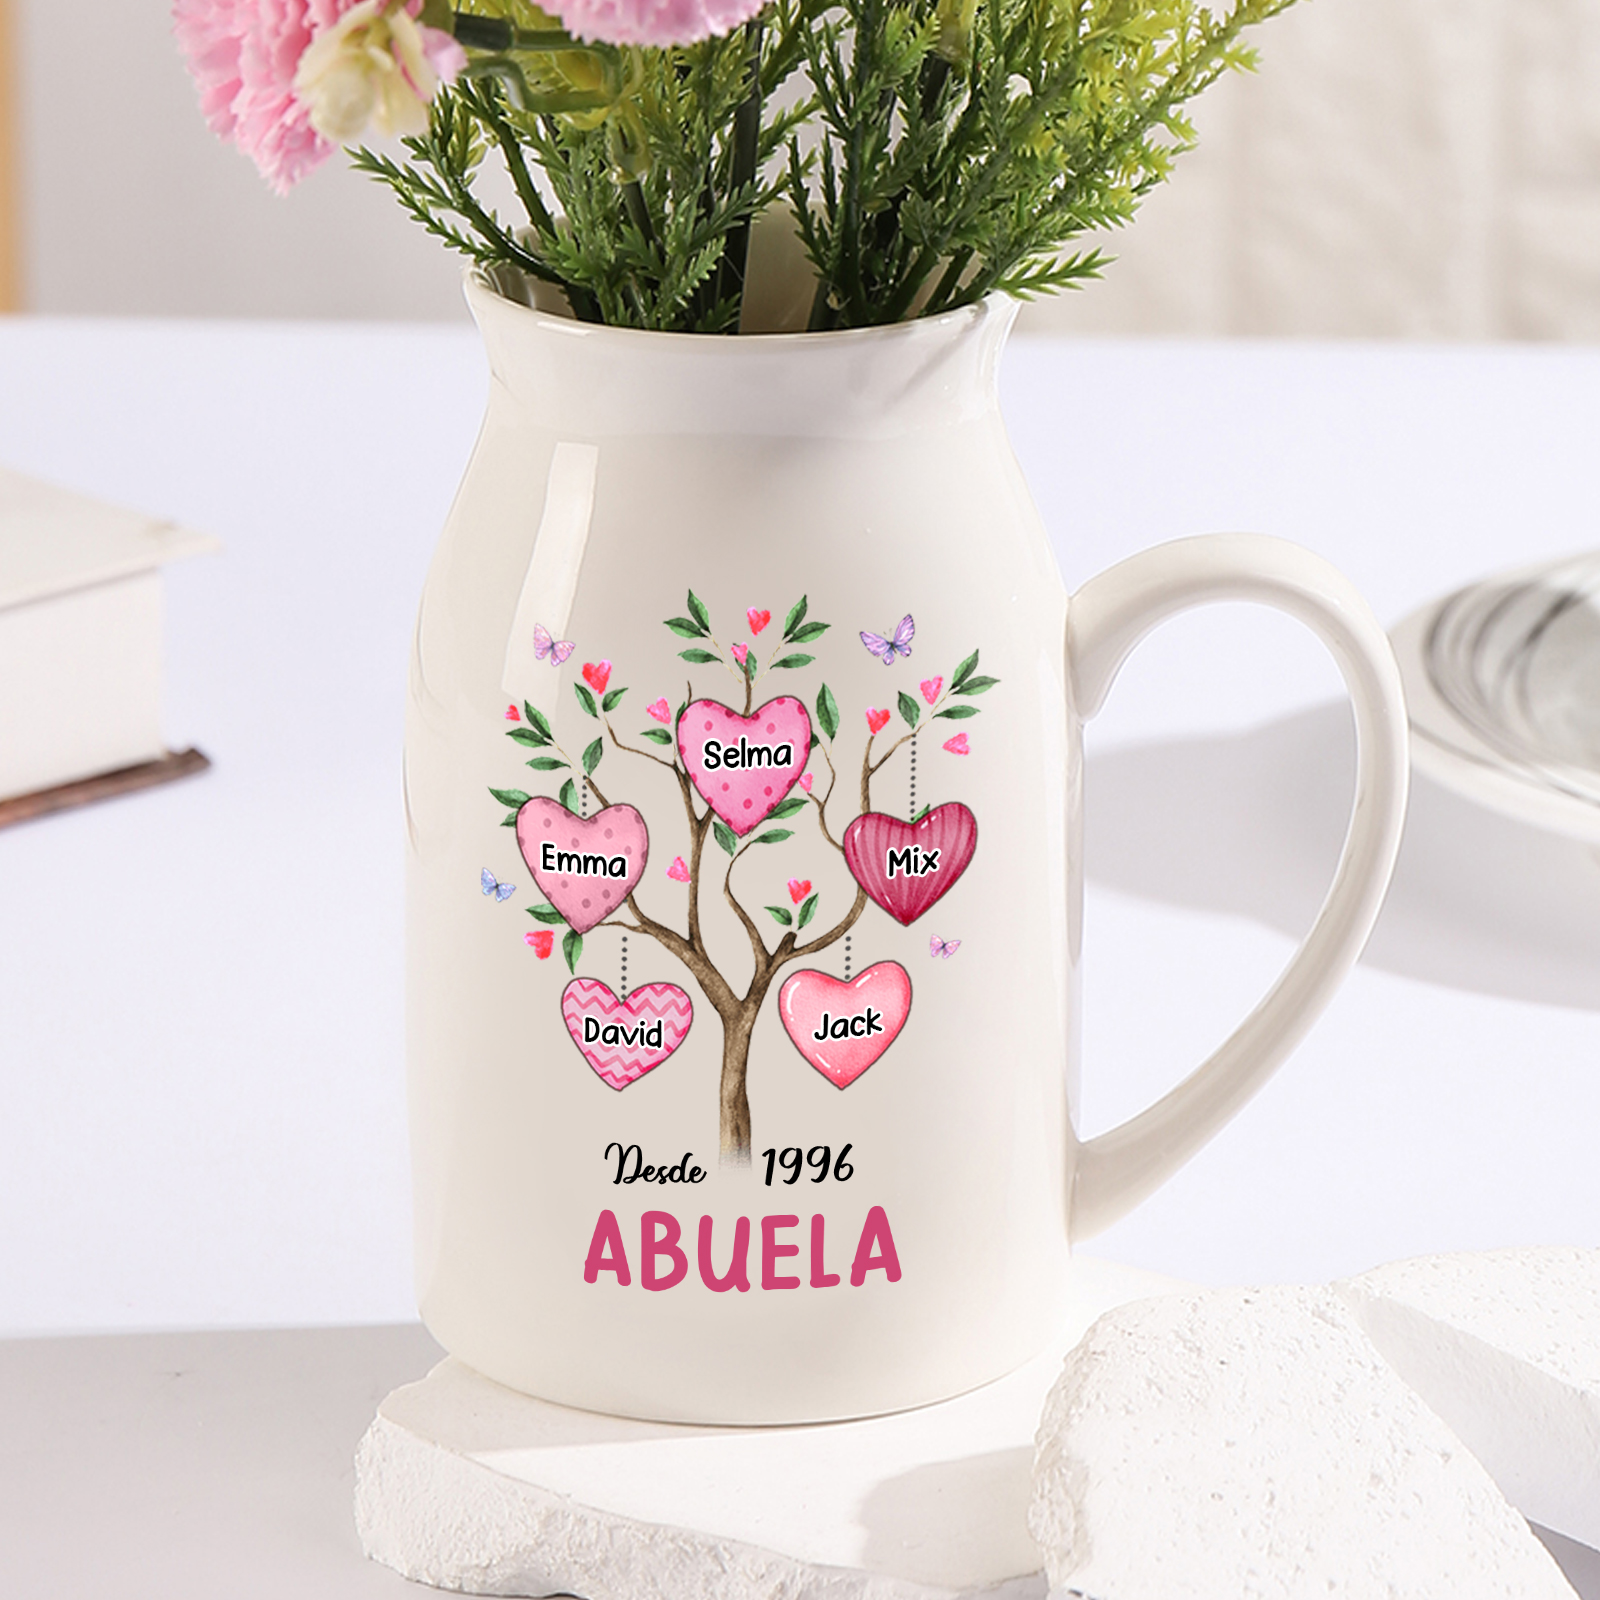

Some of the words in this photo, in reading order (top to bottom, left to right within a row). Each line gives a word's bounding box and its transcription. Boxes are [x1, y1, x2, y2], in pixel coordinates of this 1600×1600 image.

[704, 737, 792, 770] Selma
[542, 843, 626, 878] Emma
[889, 846, 939, 877] Mix
[584, 1017, 662, 1049] David
[814, 1007, 883, 1041] Jack
[604, 1142, 707, 1185] Desde
[762, 1143, 854, 1187] 1996
[583, 1205, 902, 1293] ABUELA
